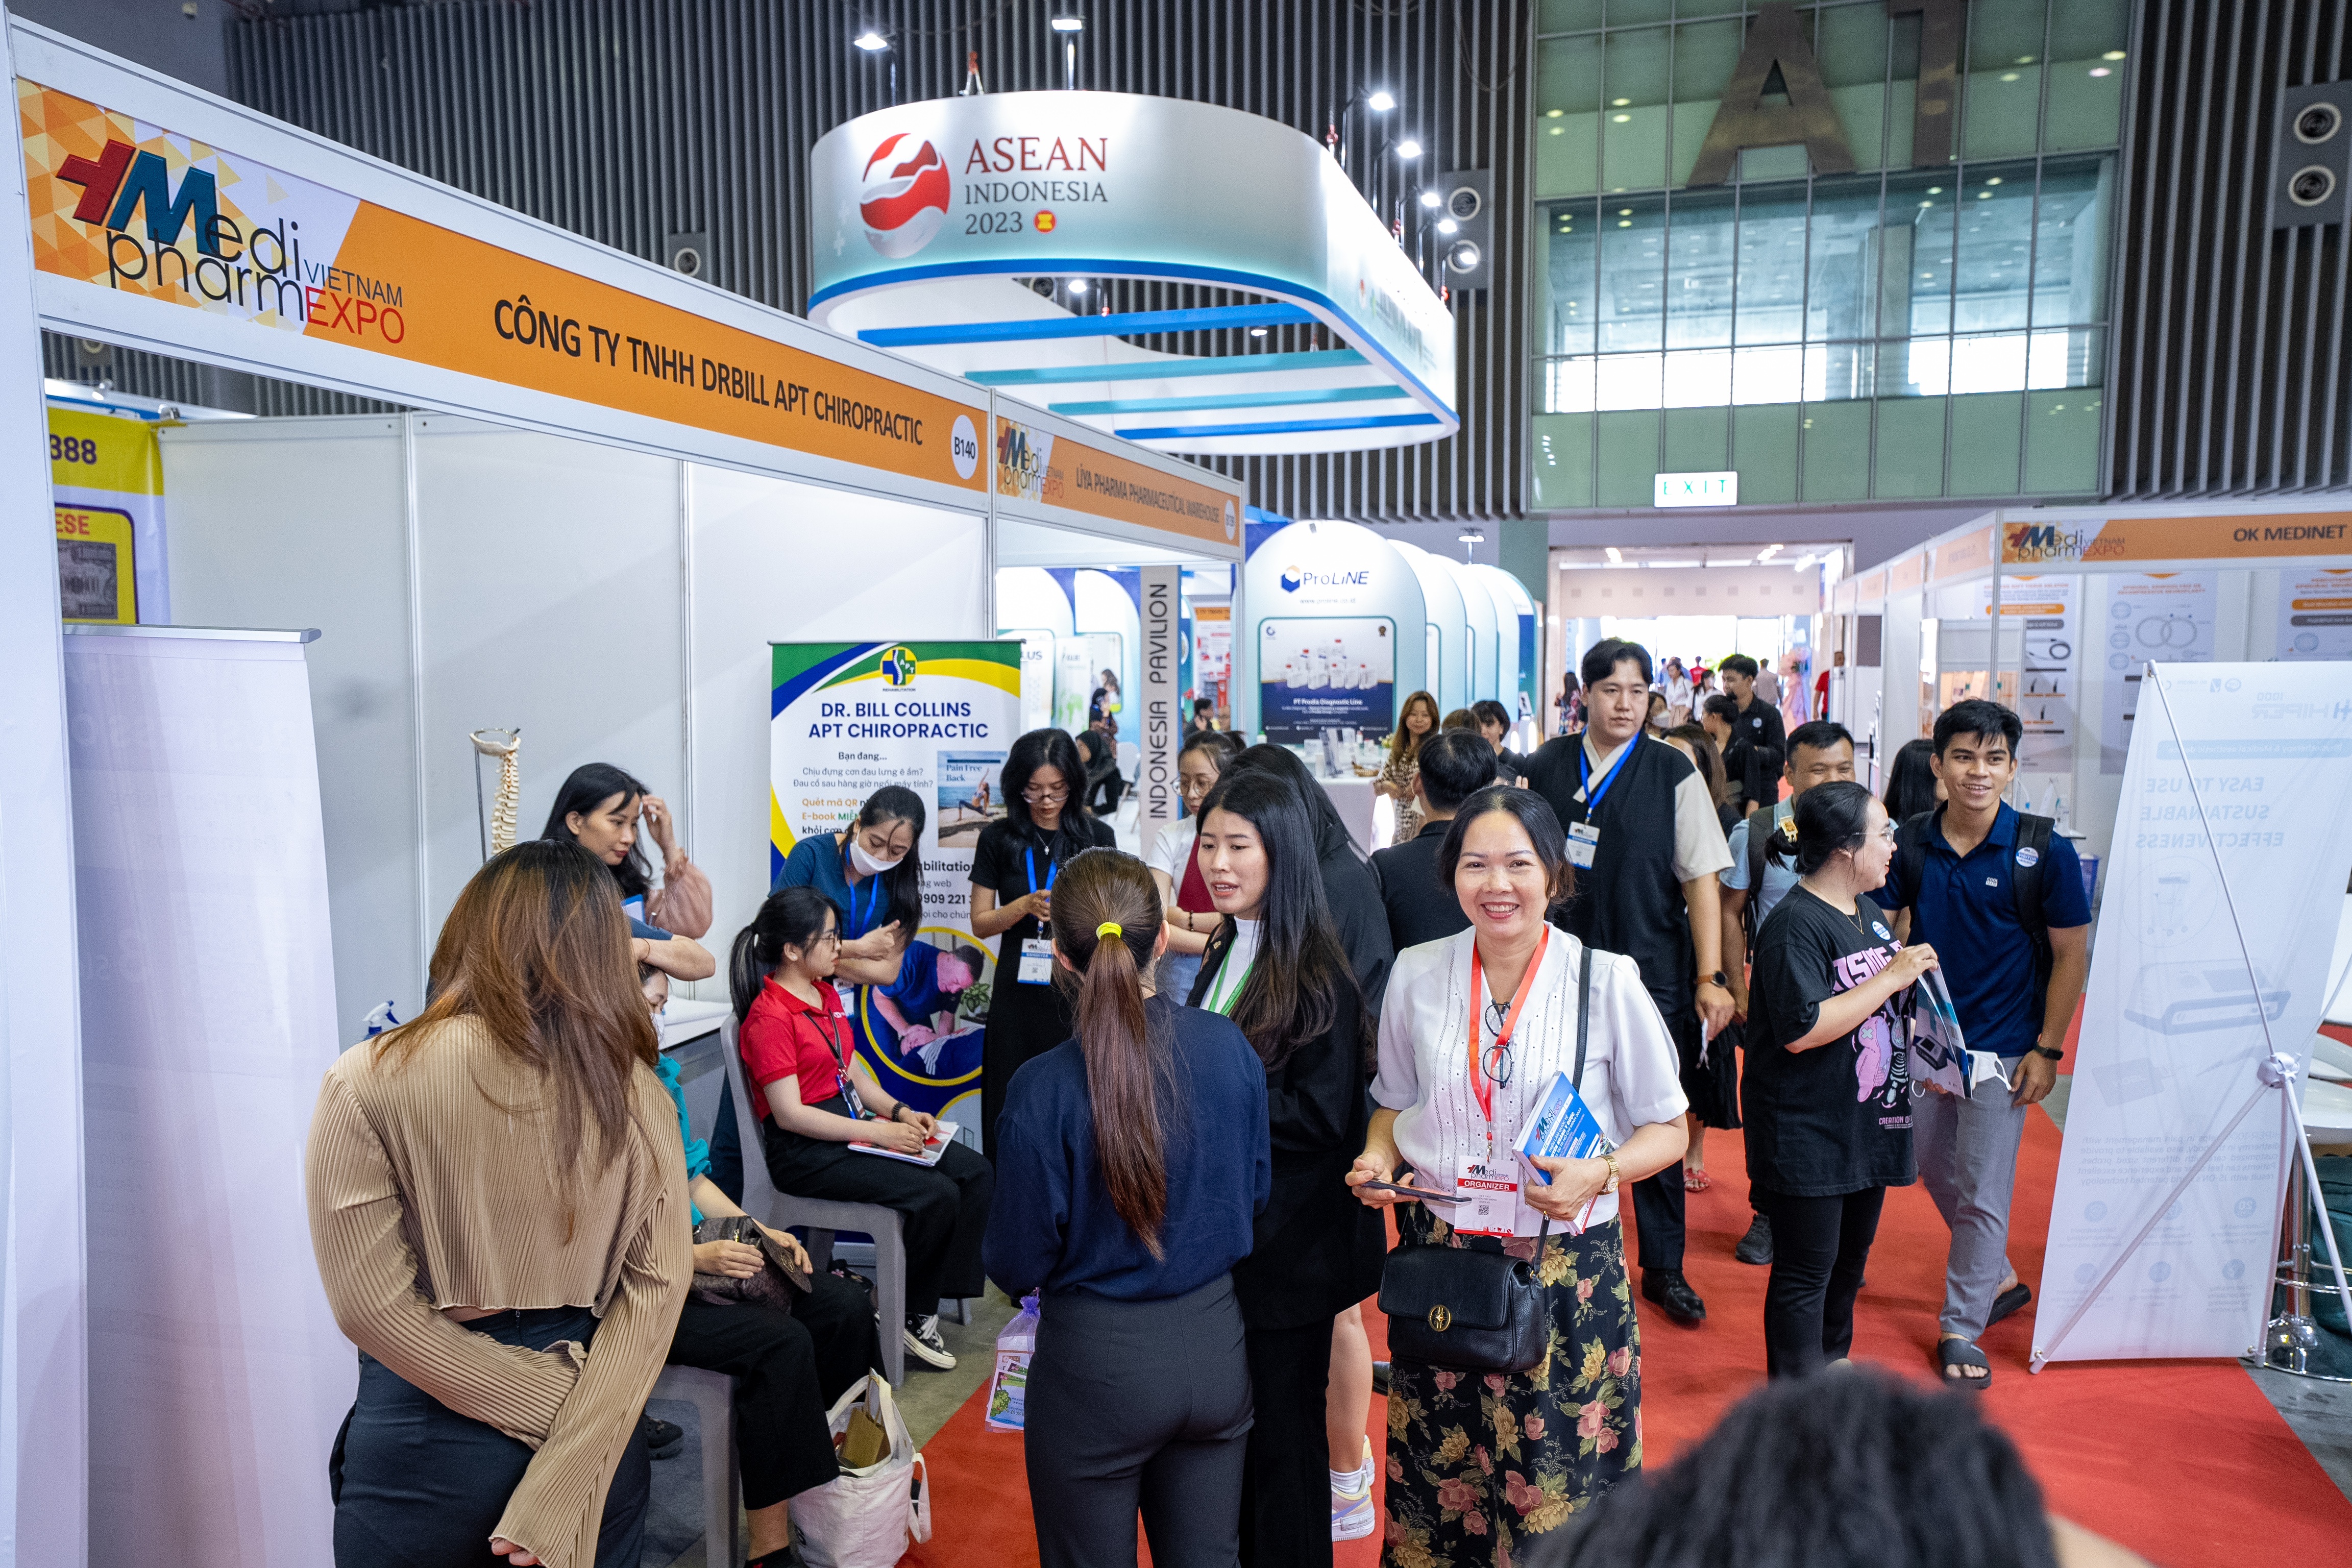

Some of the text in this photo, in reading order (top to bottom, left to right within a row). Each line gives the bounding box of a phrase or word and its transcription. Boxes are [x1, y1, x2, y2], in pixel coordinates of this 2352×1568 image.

[965, 136, 1108, 174] ASEAN
[965, 181, 1108, 205] INDONESIA
[107, 150, 302, 281] Medi
[965, 211, 1023, 235] 2023
[106, 227, 405, 344] pharm EXPO
[304, 259, 403, 308] VIETNAM
[495, 294, 923, 446] CÔNG TY TNHH DRBILL APT CHIROPRACTIC
[954, 436, 976, 460] B140
[1005, 429, 1042, 475] Medi
[1094, 473, 1128, 500] PHARMA
[1129, 482, 1186, 516] PHARMACEUTICAL
[1663, 479, 1728, 495] EXIT
[2020, 526, 2083, 548] Medi
[2234, 524, 2347, 542] OK MEDINET
[2019, 545, 2125, 560] pharm EXPO
[1149, 583, 1168, 683] PAVILION
[899, 658, 915, 674] APT
[1320, 697, 1350, 706] Diagnostic
[821, 702, 971, 718] DR. BILL COLLINS
[808, 723, 989, 739] APT CHIROPRACTIC
[839, 751, 887, 762] Bạn đang...
[1149, 701, 1168, 819] INDONESIA
[878, 767, 898, 777] lưng
[838, 779, 857, 788] hàng
[802, 798, 824, 807] Quét
[845, 798, 858, 807] QR
[802, 812, 835, 820] E-book
[948, 894, 966, 904] 221
[1879, 1116, 1904, 1125] CREATION
[1472, 1164, 1497, 1175] Medi
[1464, 1180, 1510, 1190] ORGANIZER
